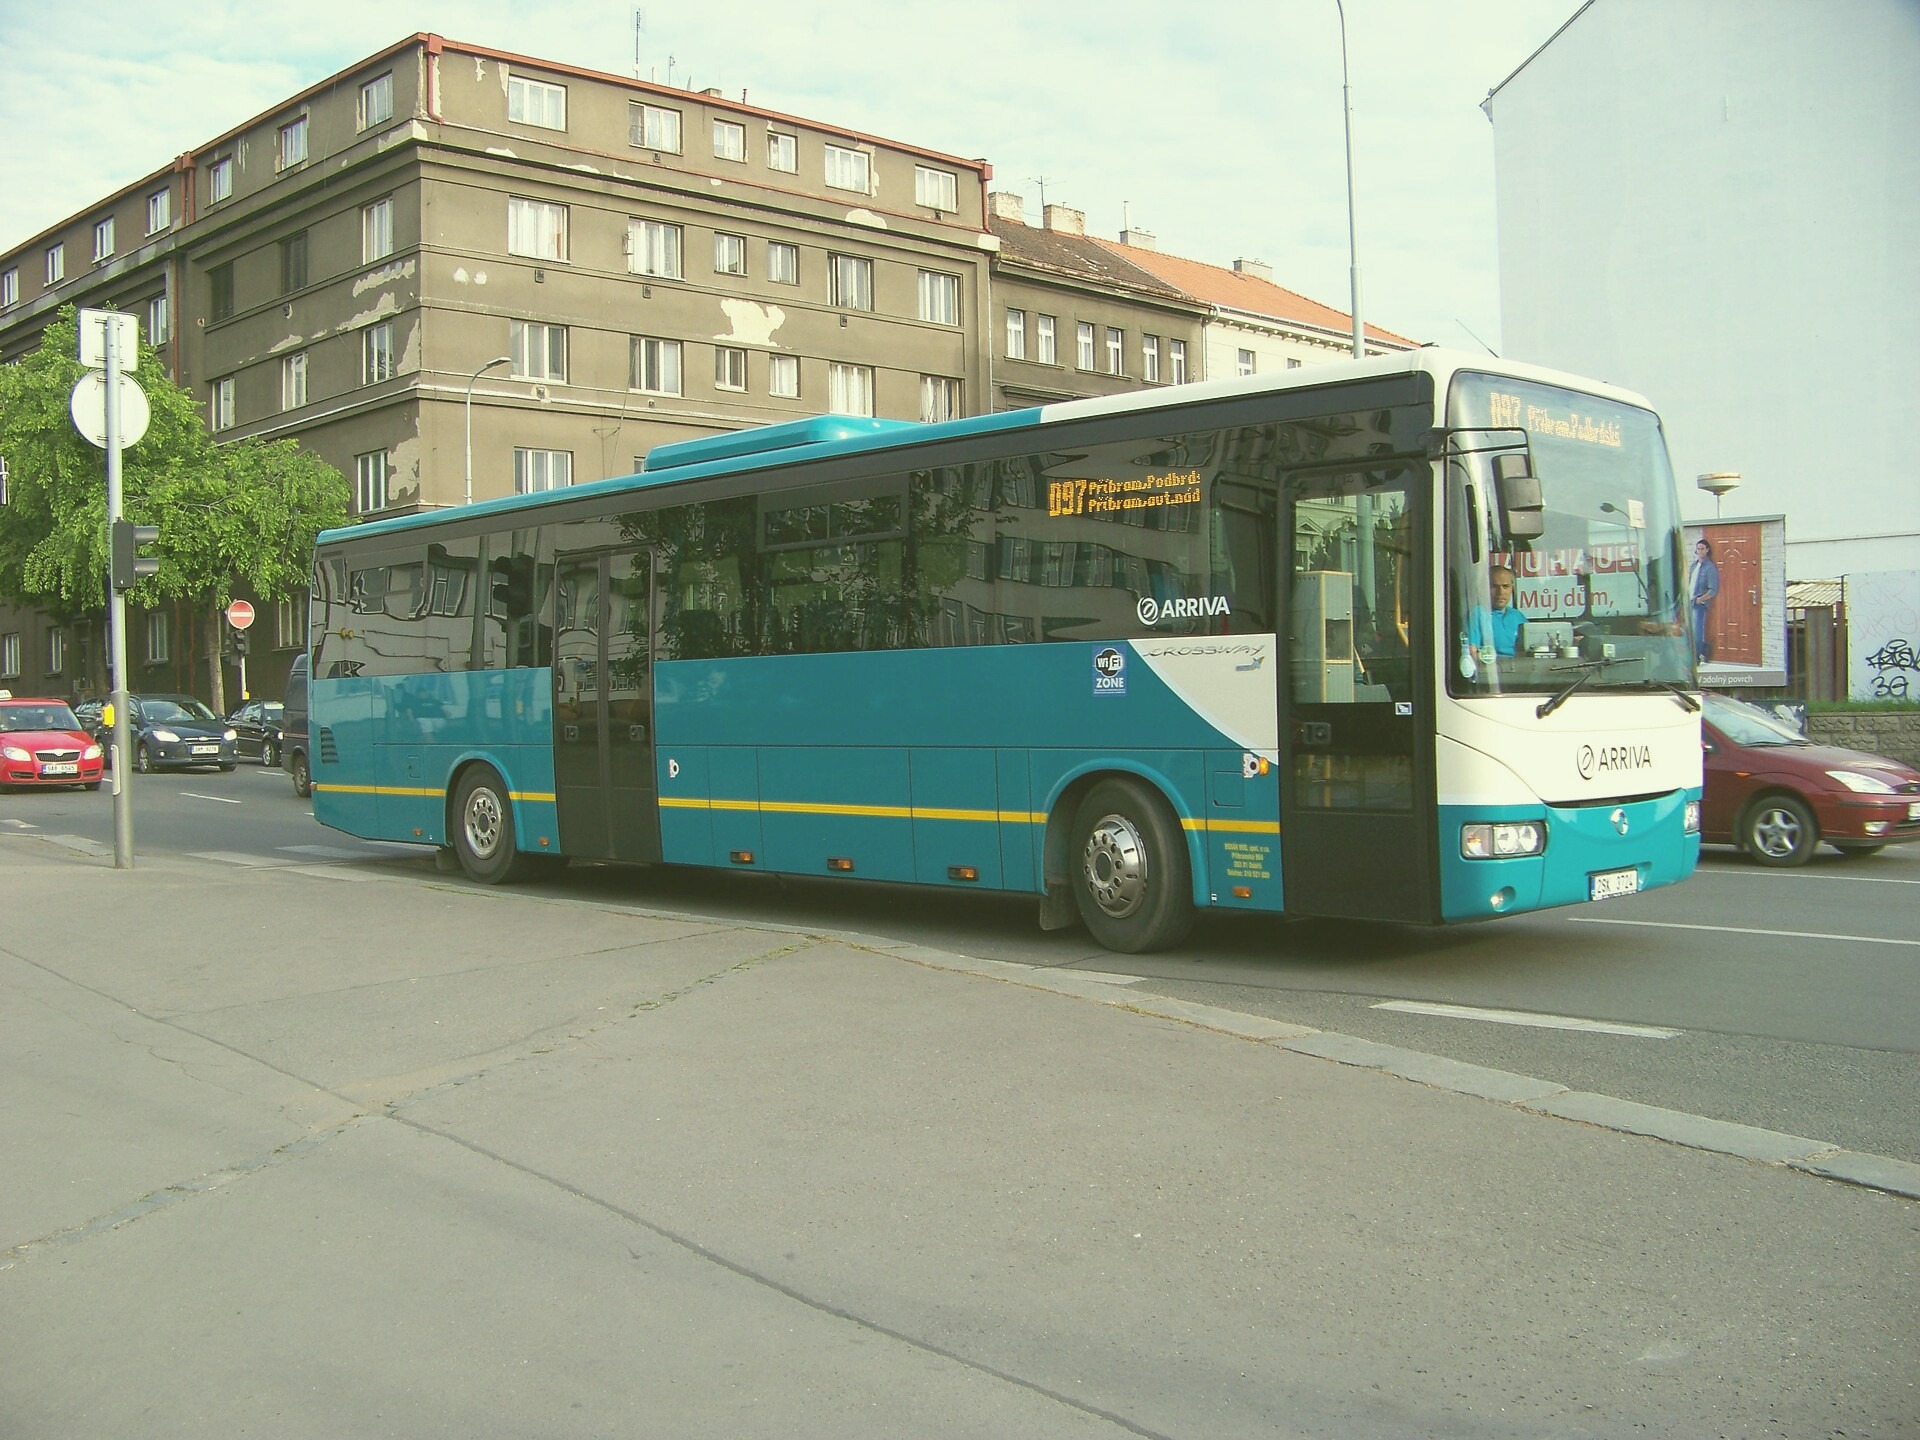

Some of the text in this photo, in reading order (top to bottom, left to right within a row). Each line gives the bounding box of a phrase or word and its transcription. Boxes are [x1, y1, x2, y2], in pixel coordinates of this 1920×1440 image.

[1049, 479, 1087, 517] D97
[1160, 596, 1230, 618] ARRIVA
[1519, 586, 1614, 612] Můj dům,
[1097, 656, 1121, 669] WiFi
[1096, 677, 1124, 689] ZONE
[1727, 675, 1752, 684] povrch
[1598, 745, 1652, 771] ARRIVA
